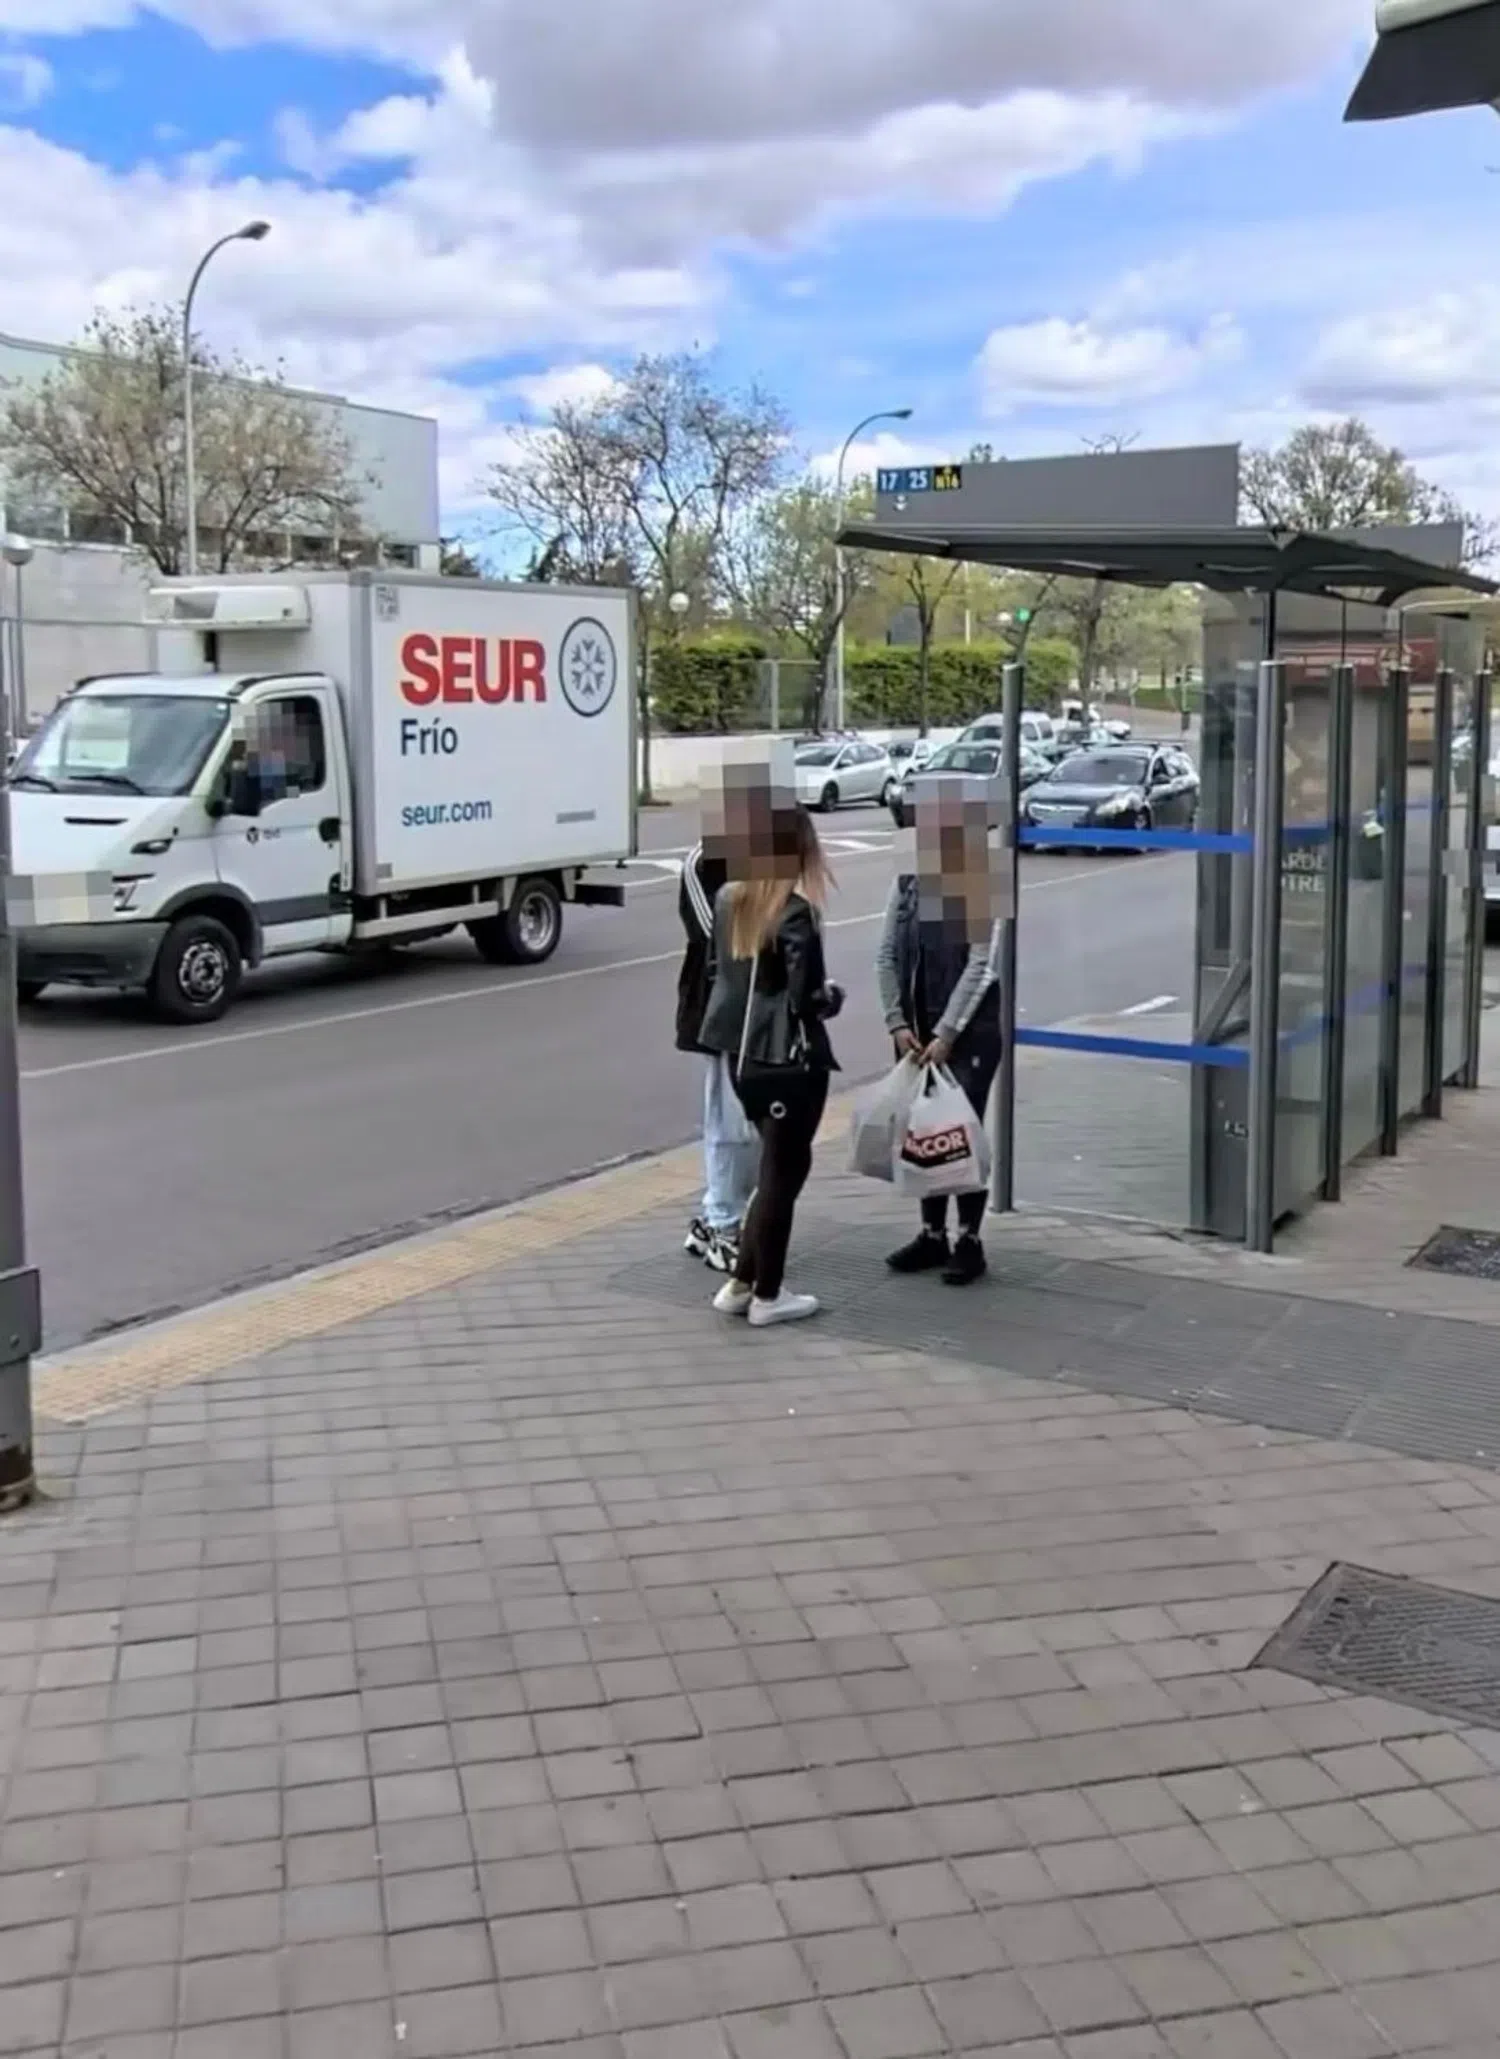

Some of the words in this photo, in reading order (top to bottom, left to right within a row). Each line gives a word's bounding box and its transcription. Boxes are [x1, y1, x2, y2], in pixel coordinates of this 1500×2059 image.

[881, 472, 898, 490] 17
[909, 470, 928, 489] 25
[399, 633, 547, 706] SEUR
[400, 718, 459, 756] Frío
[401, 799, 493, 827] seur.com
